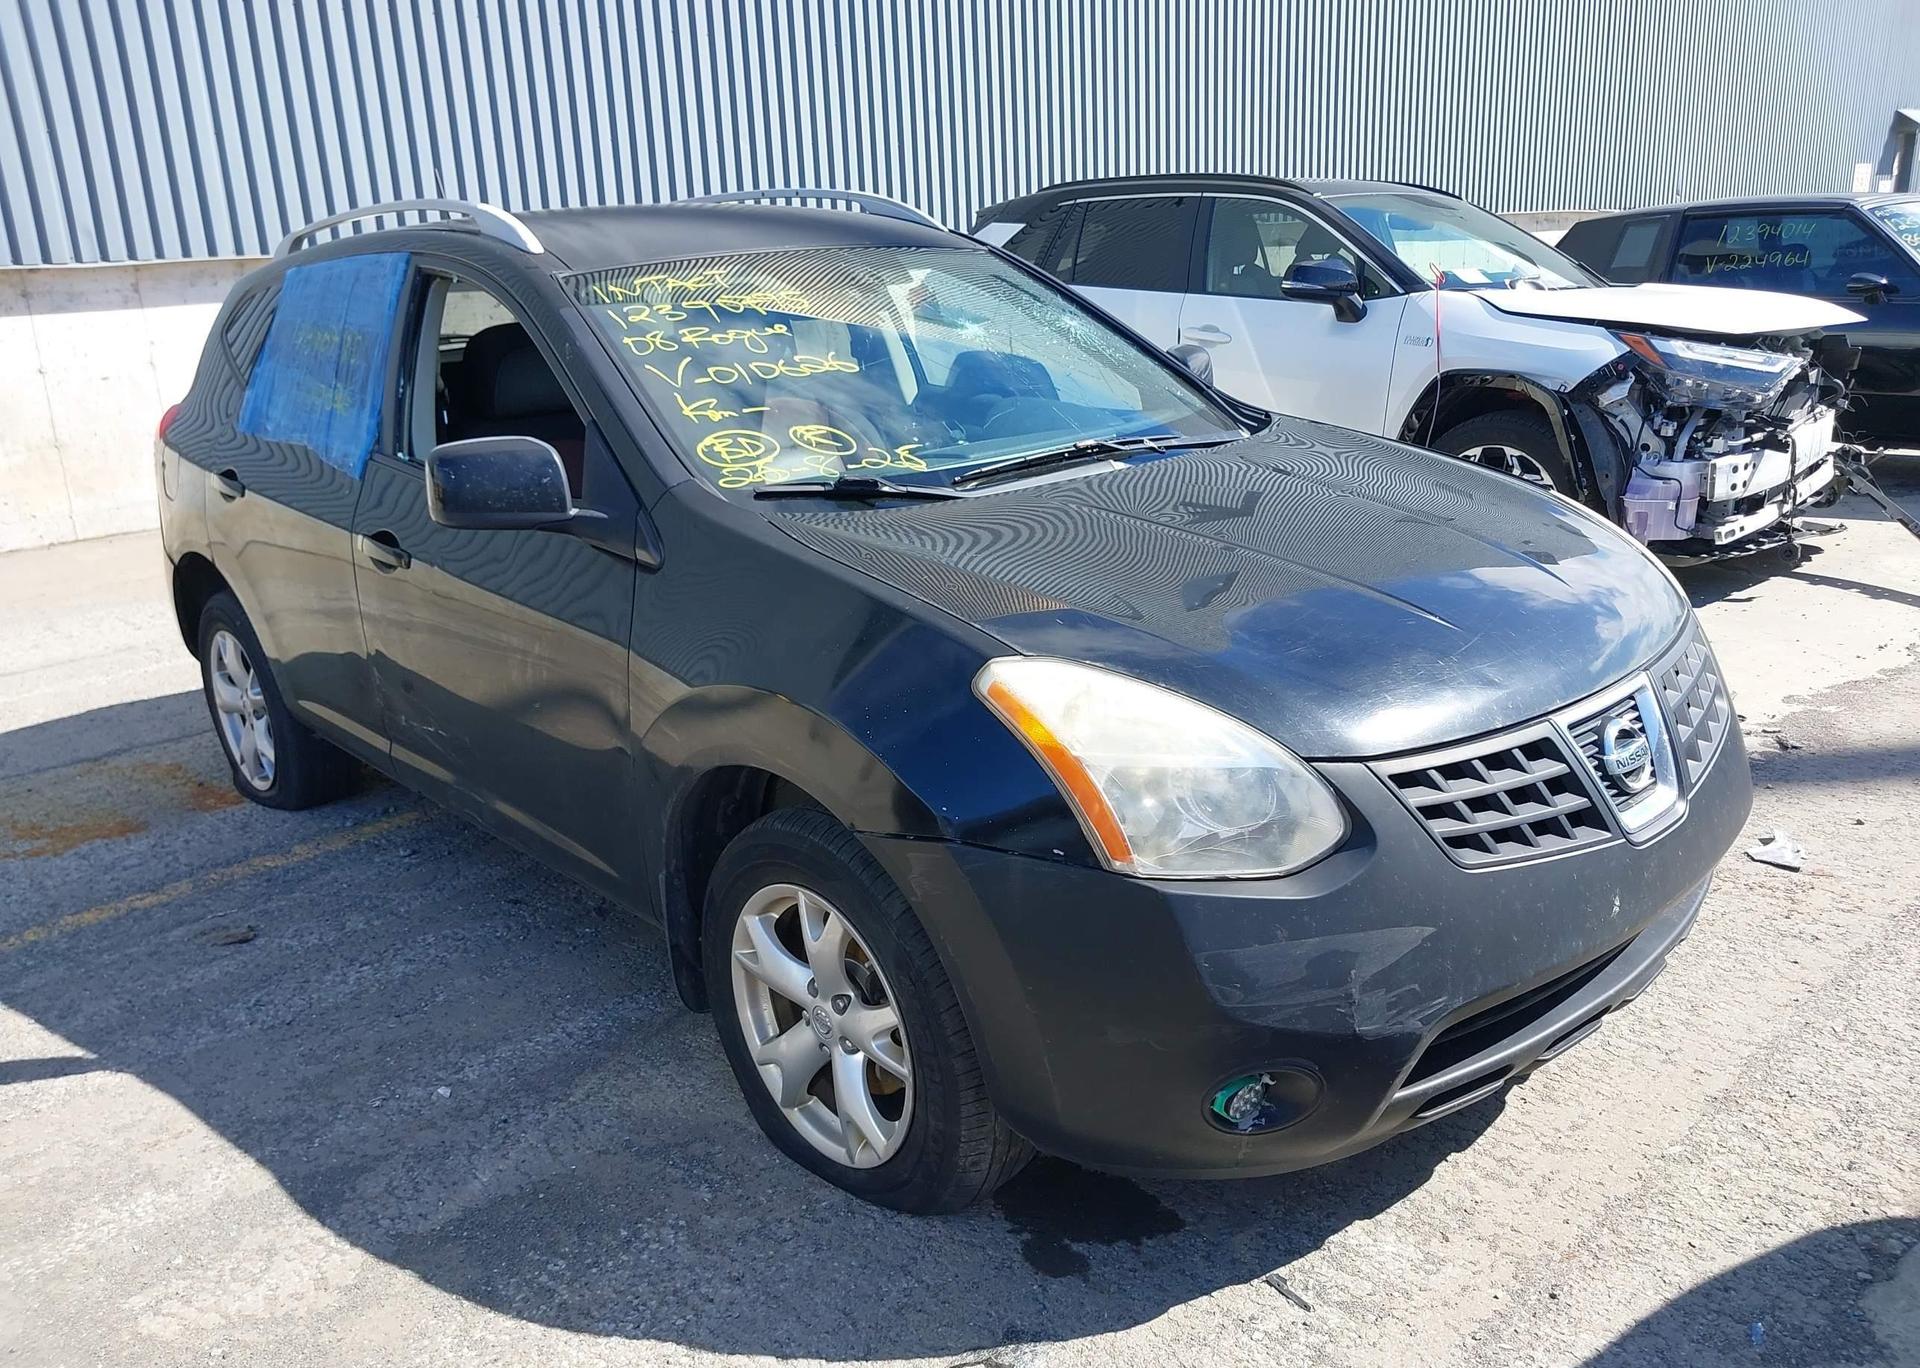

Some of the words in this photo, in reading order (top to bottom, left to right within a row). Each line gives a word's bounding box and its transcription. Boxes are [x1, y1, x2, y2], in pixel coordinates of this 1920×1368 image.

[1716, 222, 1817, 247] 12394014
[1705, 251, 1811, 274] V-224964
[592, 269, 731, 303] INTACT
[679, 323, 793, 353] Rogue
